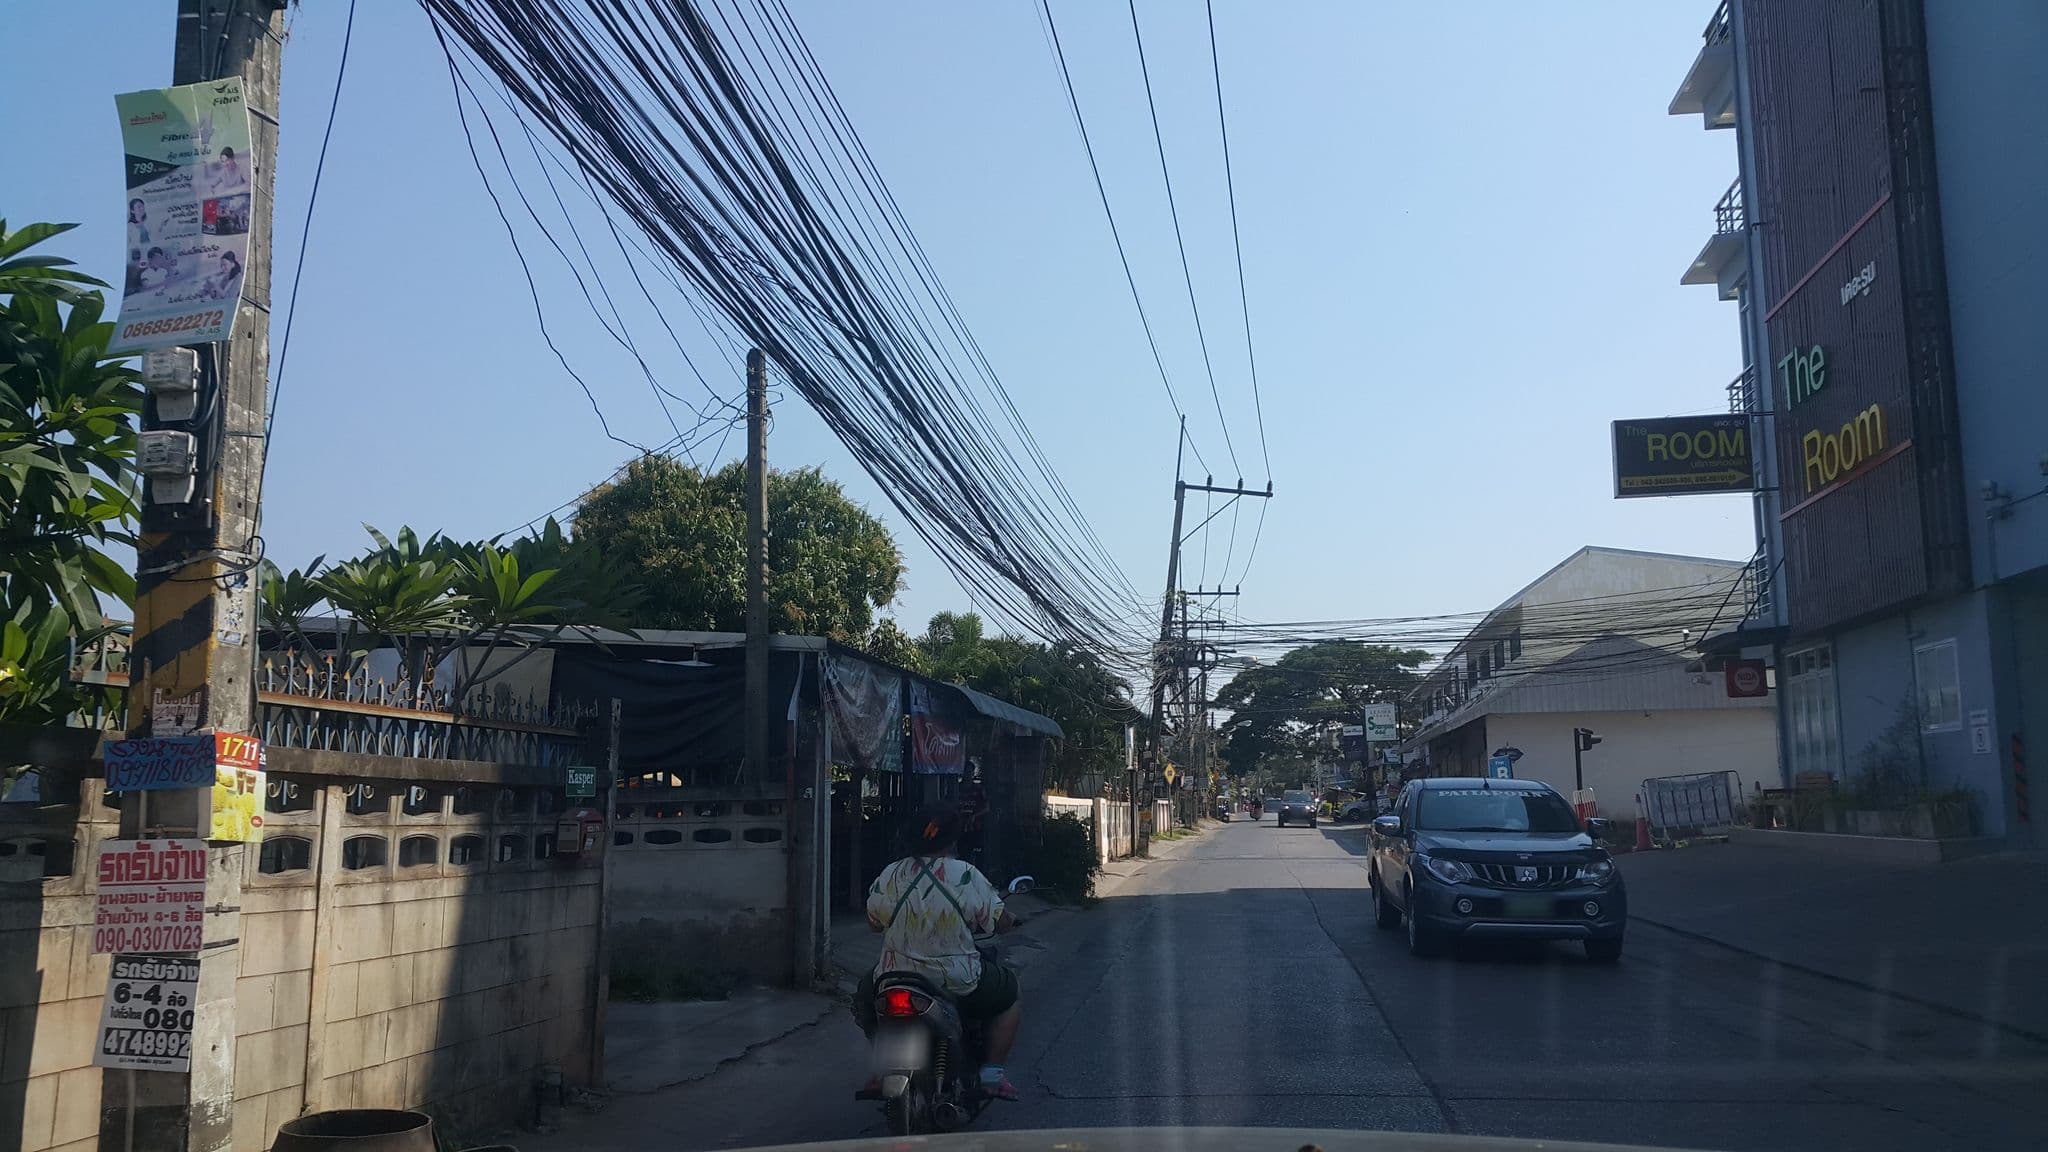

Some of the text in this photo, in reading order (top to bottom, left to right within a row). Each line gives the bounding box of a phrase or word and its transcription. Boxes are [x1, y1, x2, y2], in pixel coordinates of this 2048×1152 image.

[213, 96, 240, 106] Fibre
[227, 86, 239, 94] AIS
[161, 133, 189, 142] Fibre
[133, 162, 154, 175] 799
[122, 309, 224, 339] 0868522272
[1778, 344, 1825, 411] The
[1624, 425, 1745, 462] The ROOM
[1803, 403, 1884, 493] Room
[222, 736, 258, 761] 1711
[567, 769, 594, 788] Kasper
[100, 840, 206, 882] รถรับจ้าง
[97, 906, 148, 925] ย้ายบ้าน
[184, 904, 203, 922] ล้อ
[96, 925, 203, 953] 090-0307023
[115, 958, 199, 980] รถรับจ้าง
[113, 982, 187, 1007] 6-4 ล้อ
[143, 1007, 195, 1031] 080
[104, 1029, 191, 1057] 4748992
